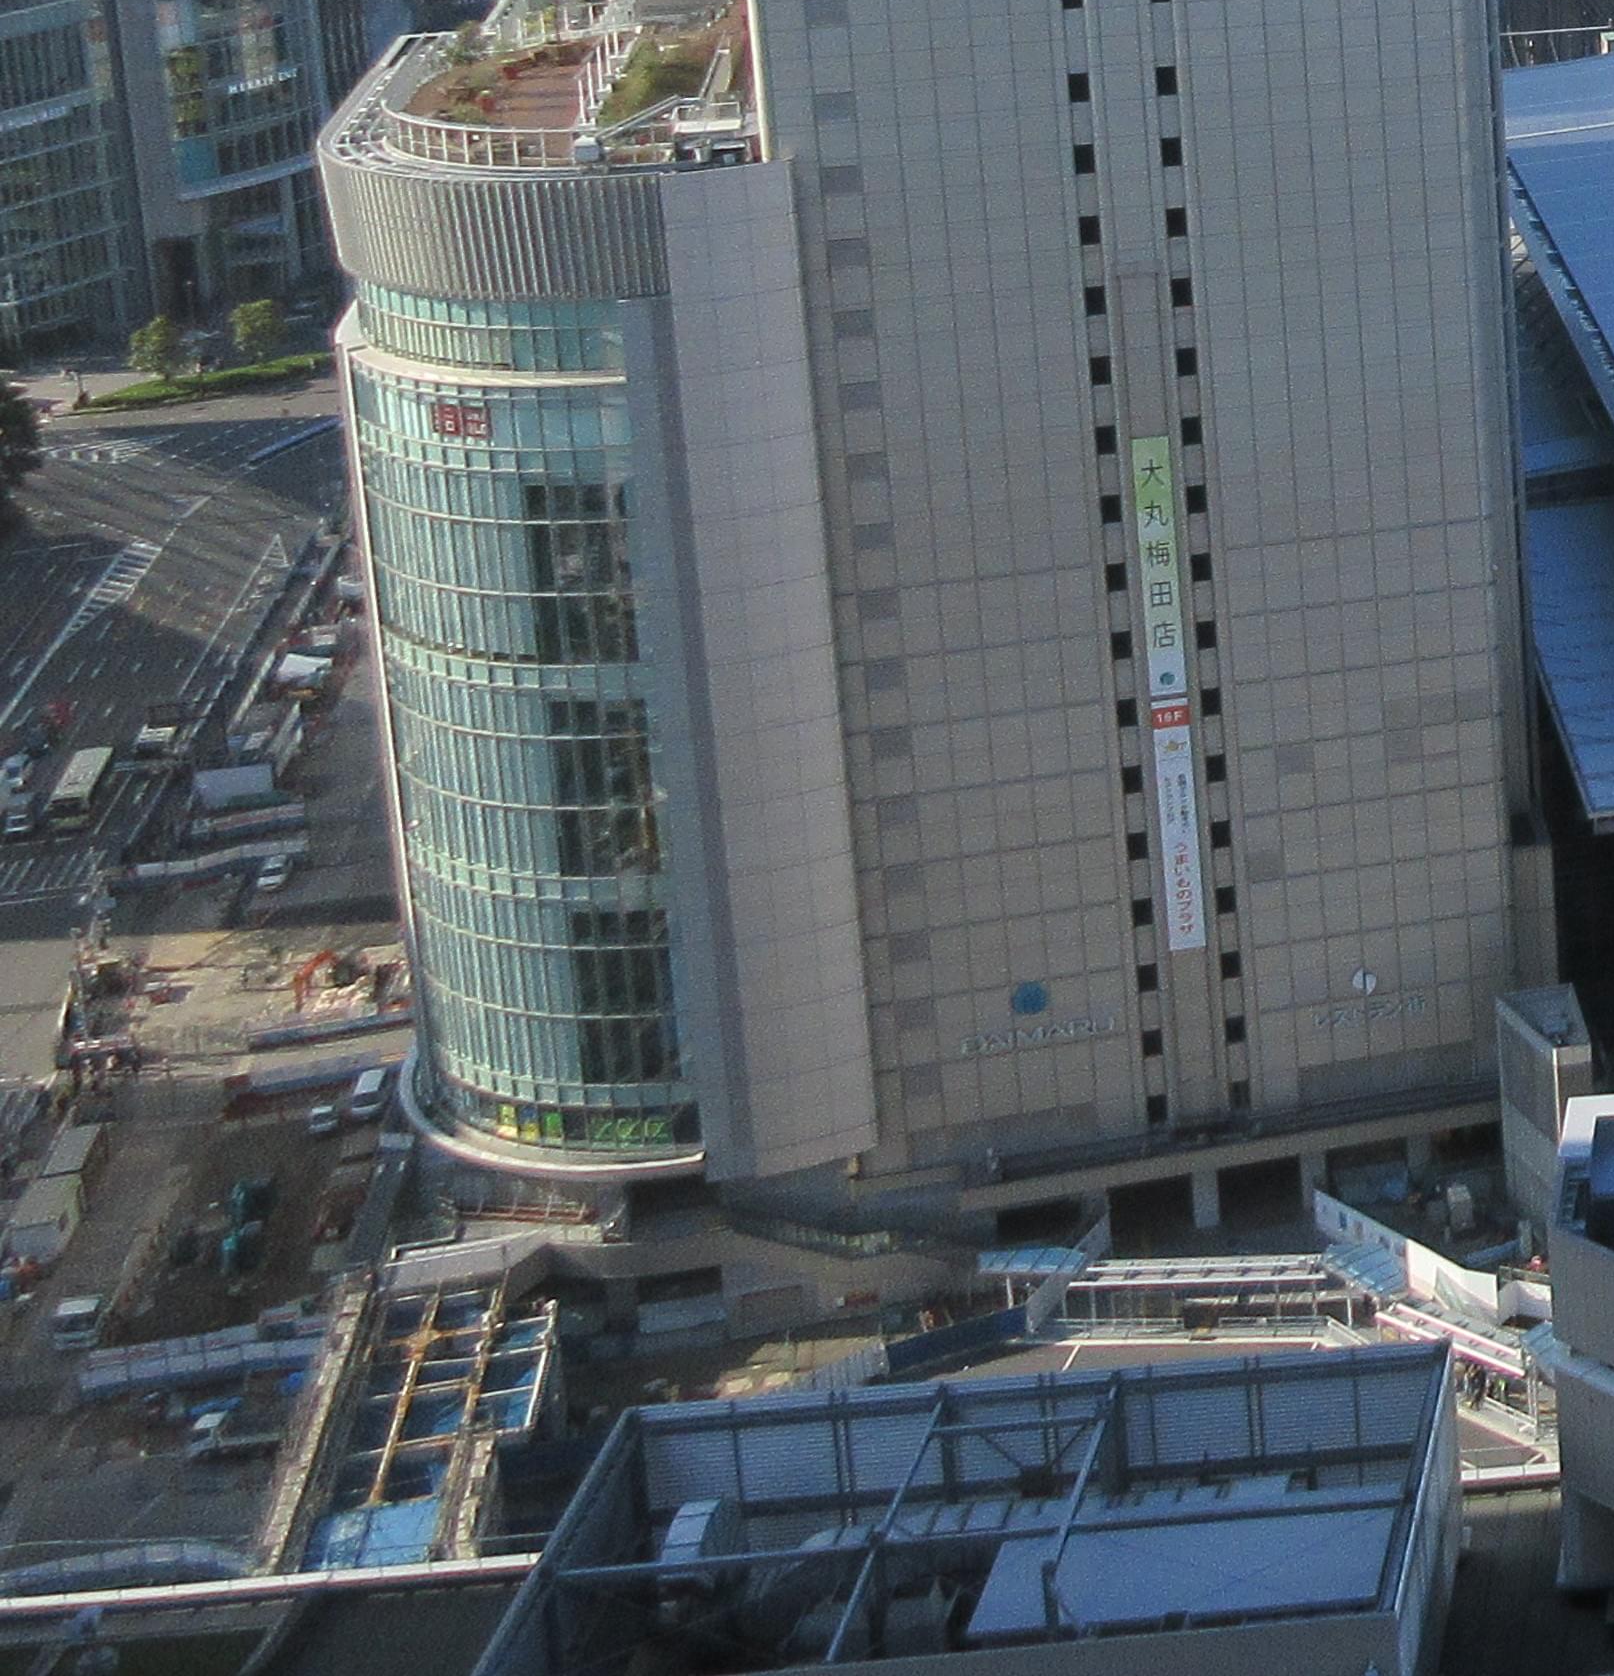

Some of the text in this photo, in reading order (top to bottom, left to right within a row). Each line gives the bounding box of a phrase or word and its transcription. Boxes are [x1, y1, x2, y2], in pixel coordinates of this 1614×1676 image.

[1138, 458, 1177, 649] 大丸梅田店
[1157, 710, 1184, 723] 16F
[959, 1016, 1117, 1056] DAIMARU
